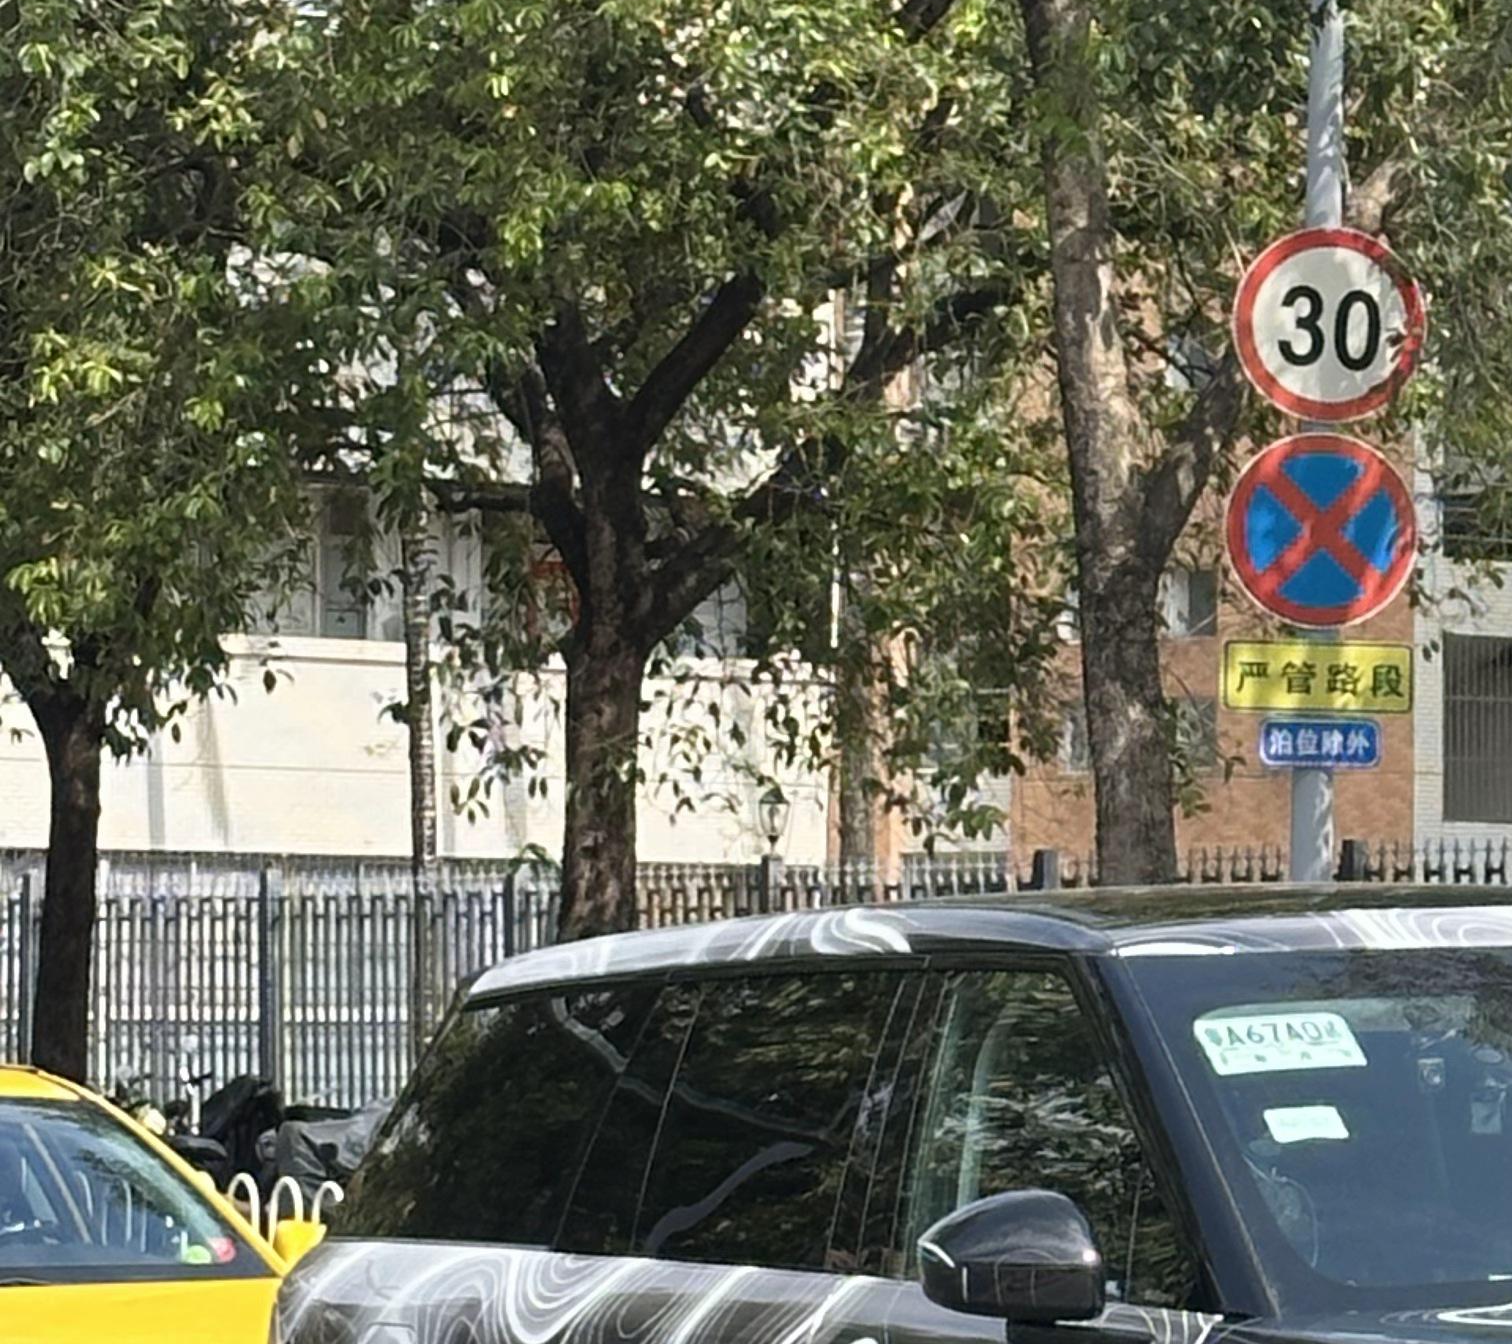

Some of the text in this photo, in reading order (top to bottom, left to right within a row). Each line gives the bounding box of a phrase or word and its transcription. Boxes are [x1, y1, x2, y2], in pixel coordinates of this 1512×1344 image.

[1278, 285, 1381, 372] 30
[1236, 660, 1404, 699] 严管路段
[1269, 727, 1371, 757] 泊位除外
